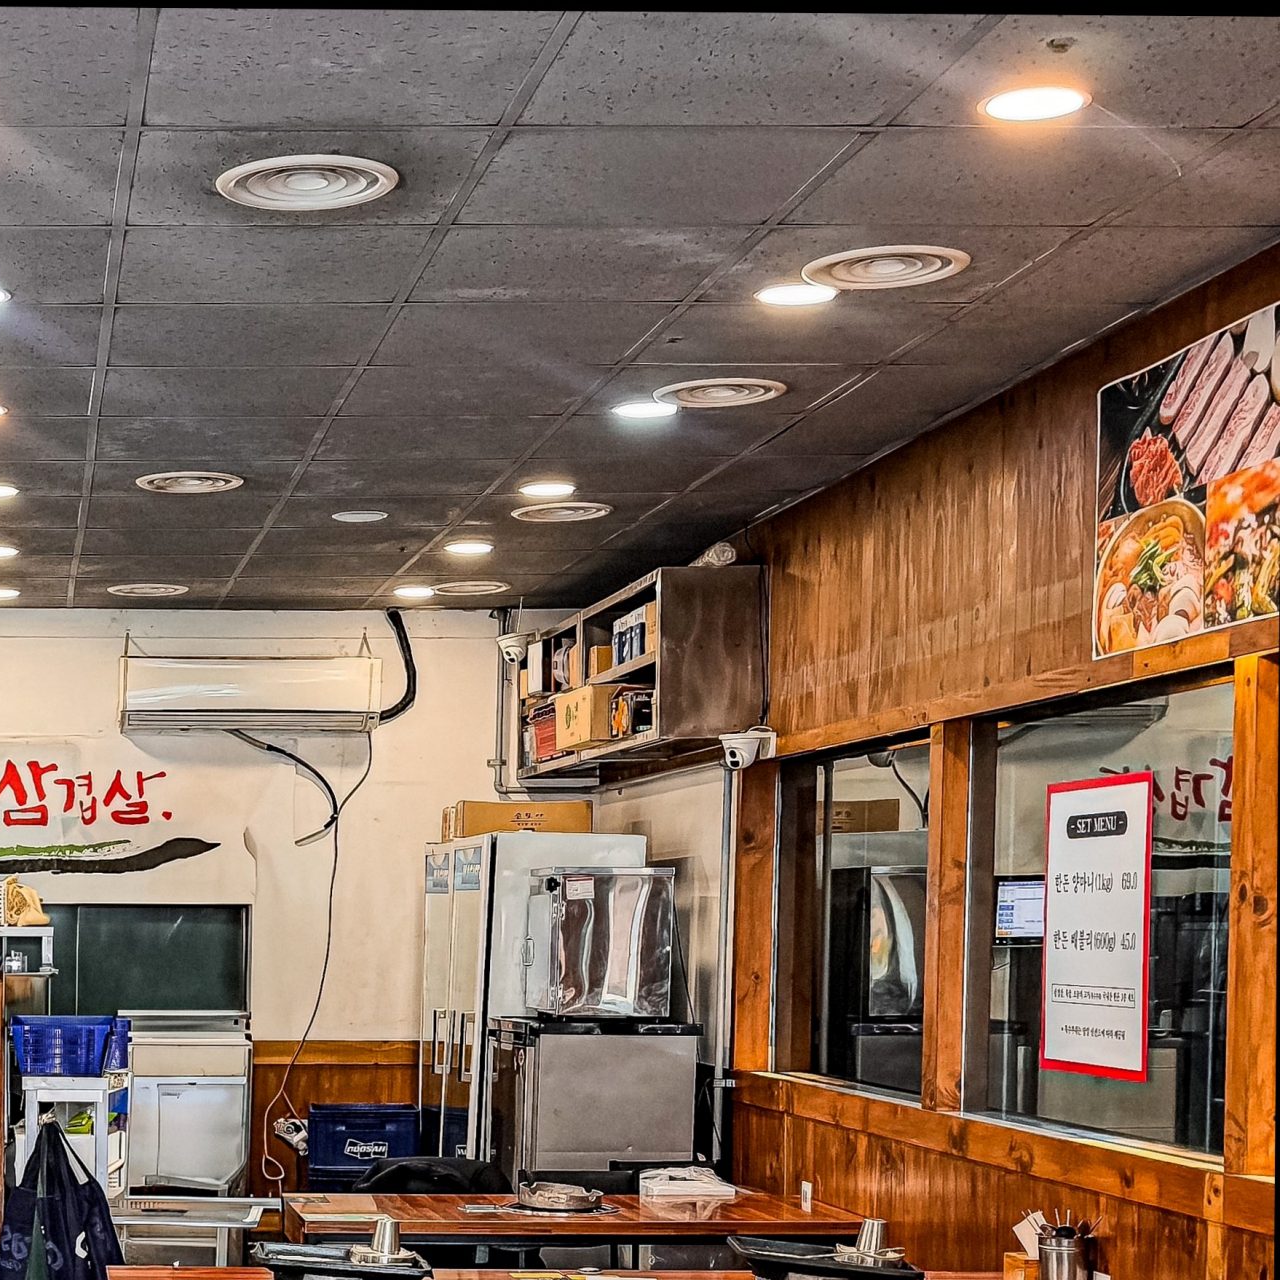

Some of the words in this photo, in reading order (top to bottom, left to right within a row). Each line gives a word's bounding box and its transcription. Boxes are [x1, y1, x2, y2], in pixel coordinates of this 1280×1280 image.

[1076, 818, 1092, 834] SET
[1093, 816, 1117, 833] MENU
[1121, 871, 1138, 891] 69.0
[1120, 932, 1137, 951] 45.0
